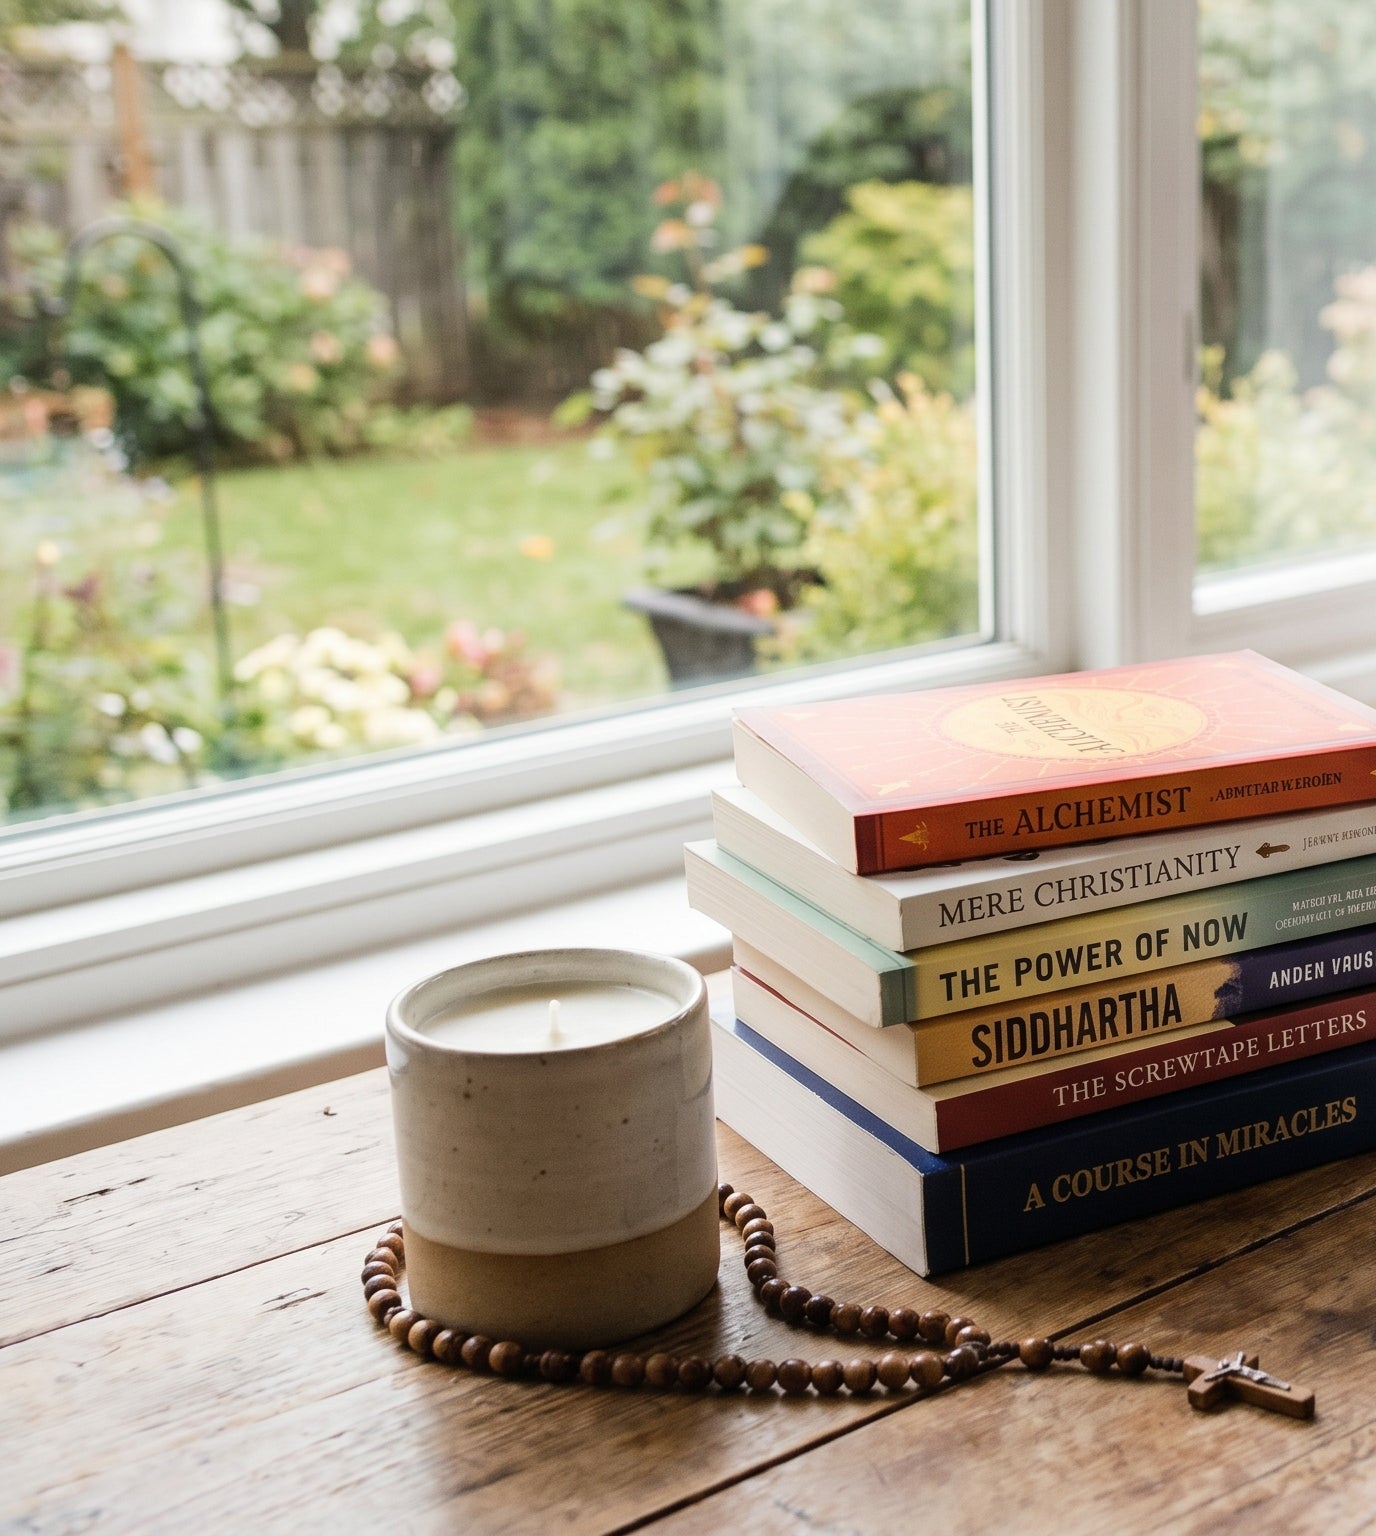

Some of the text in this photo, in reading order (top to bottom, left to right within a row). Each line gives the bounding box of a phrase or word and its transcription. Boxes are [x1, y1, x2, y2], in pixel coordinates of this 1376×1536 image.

[965, 786, 1191, 839] THE ALCHEMIST
[937, 846, 1241, 928] MERE CHRISTIANITY
[939, 912, 1248, 1001] THE POWER OF NOW
[1269, 961, 1324, 989] ANDEN
[971, 983, 1182, 1068] SIDDHARTHA
[1053, 1010, 1367, 1107] THE SCREWTAPE LETTERS
[1023, 1096, 1358, 1212] A COURSE IN MIRACLES
